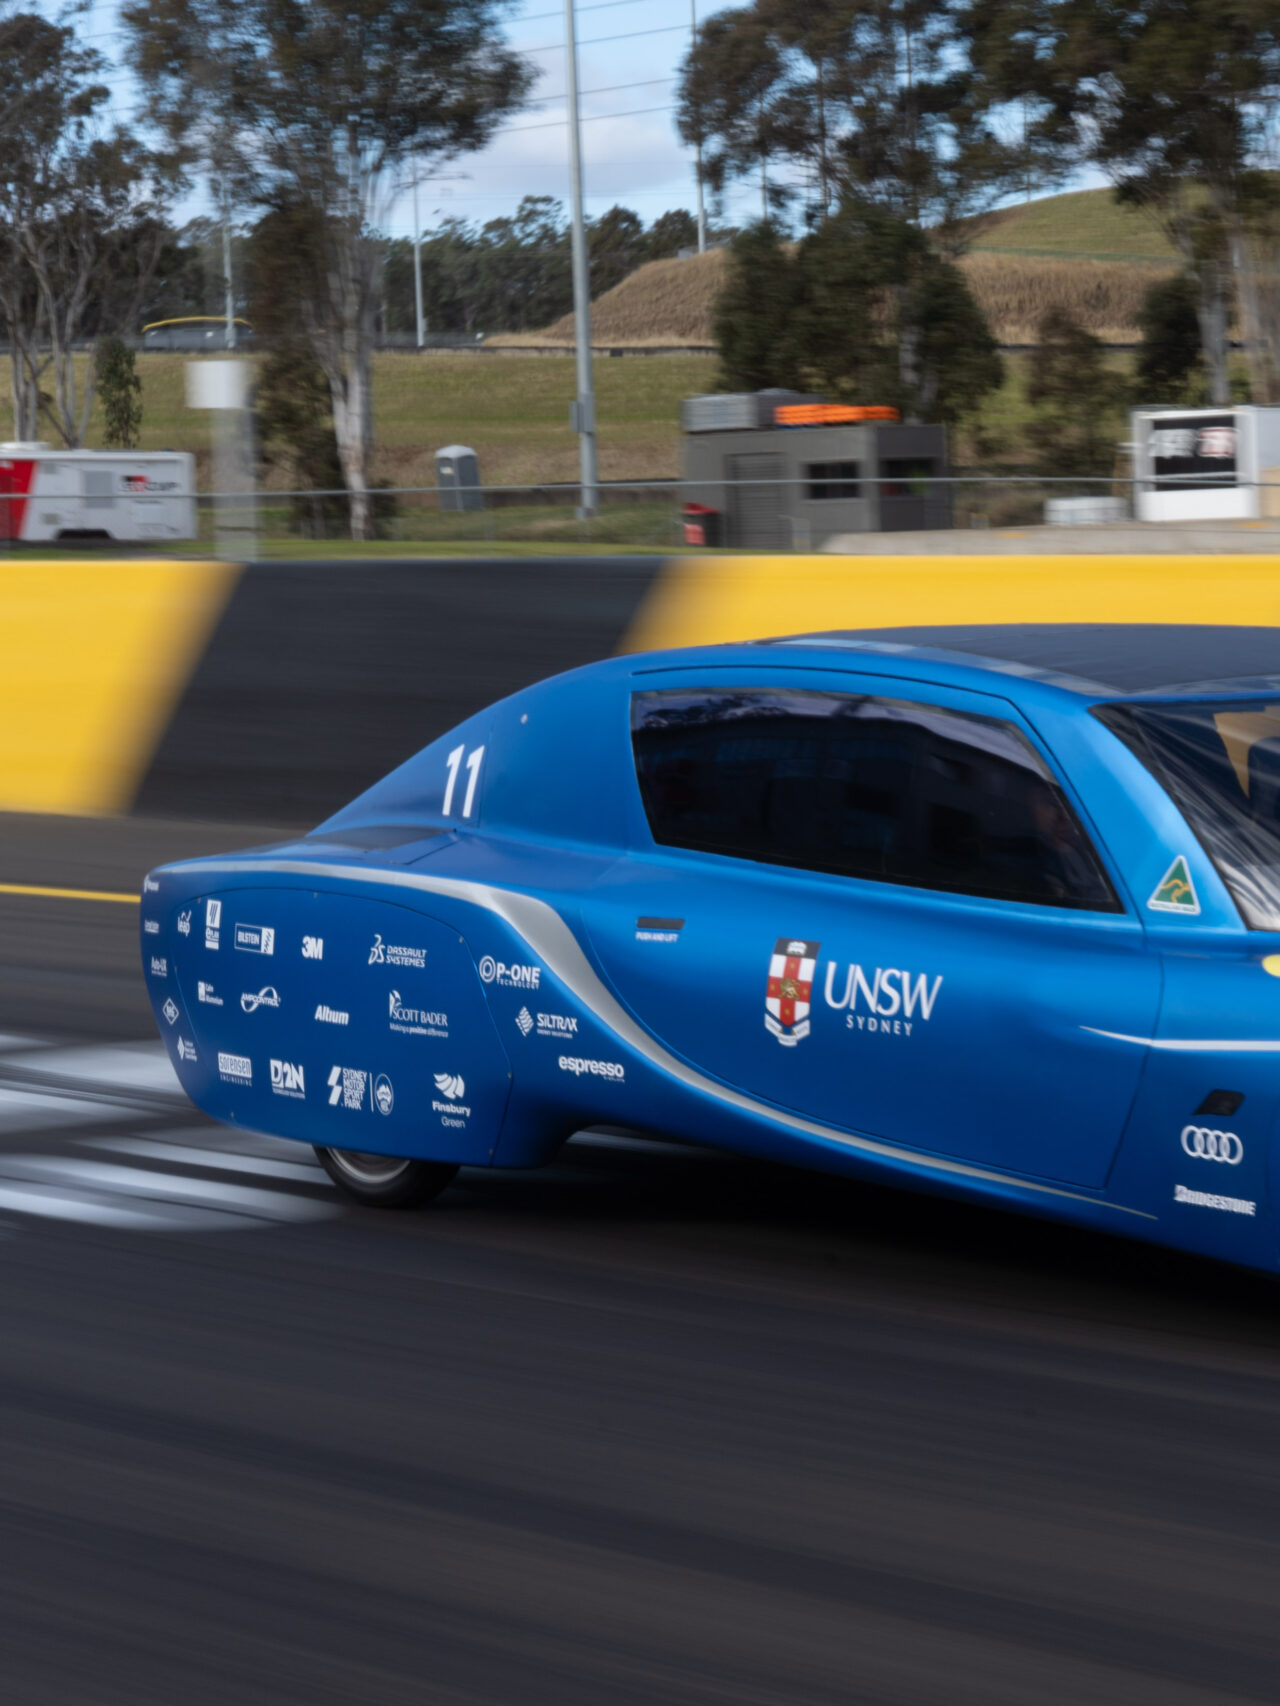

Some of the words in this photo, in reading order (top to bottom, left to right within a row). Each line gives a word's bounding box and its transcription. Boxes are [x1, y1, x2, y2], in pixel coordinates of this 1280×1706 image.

[442, 743, 485, 818] 11
[301, 936, 324, 960] 3M
[387, 945, 427, 958] DASSAULT
[496, 962, 541, 984] P-ONE
[496, 979, 540, 990] TECHNOLOGY
[824, 960, 944, 1021] UNSW
[314, 1004, 350, 1026] Altium
[392, 1007, 420, 1022] SCOTT
[420, 1011, 449, 1027] BADER
[846, 1014, 913, 1037] SYDNEY
[342, 1067, 368, 1082] SYDNEY
[558, 1055, 625, 1077] espresso
[344, 1098, 362, 1110] PARK
[432, 1101, 471, 1117] Finsbury
[441, 1116, 466, 1128] Green
